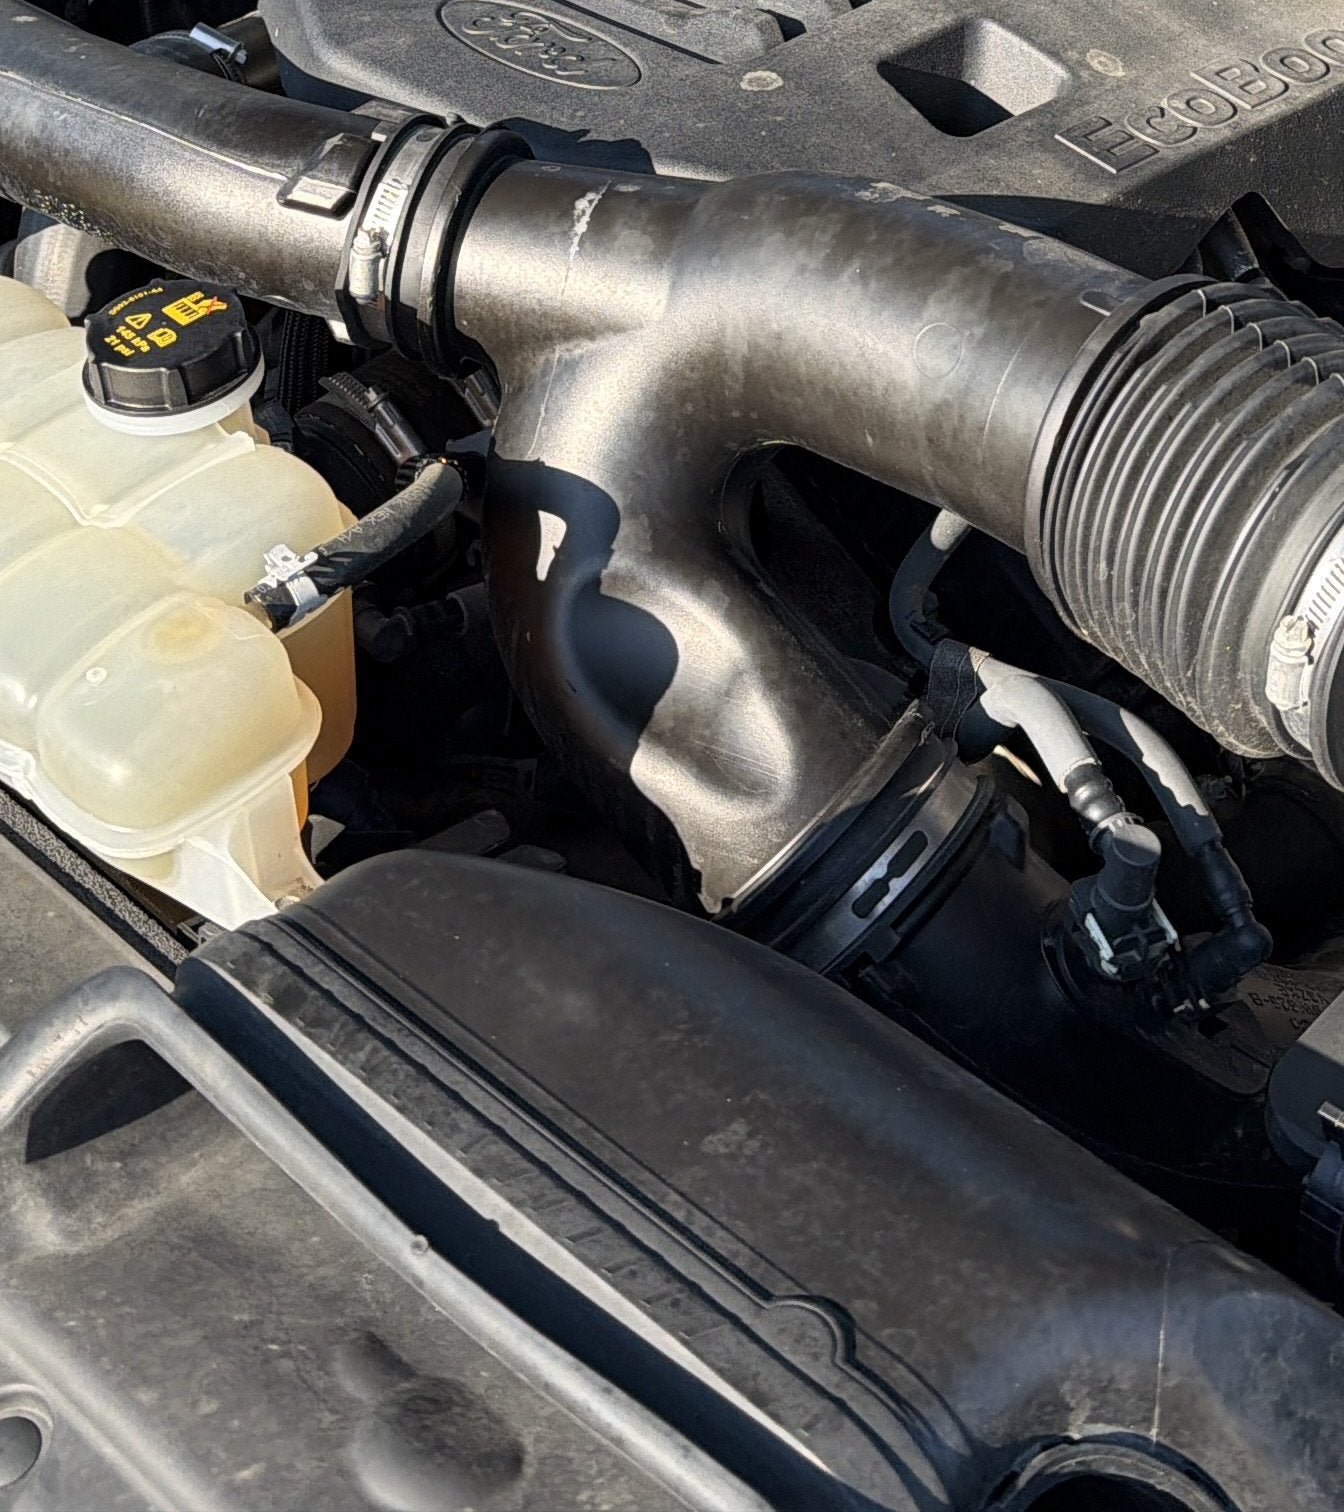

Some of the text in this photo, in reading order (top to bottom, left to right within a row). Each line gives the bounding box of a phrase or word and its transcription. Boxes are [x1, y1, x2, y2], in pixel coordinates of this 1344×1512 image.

[459, 9, 619, 76] Ford
[104, 335, 135, 356] 21 psi
